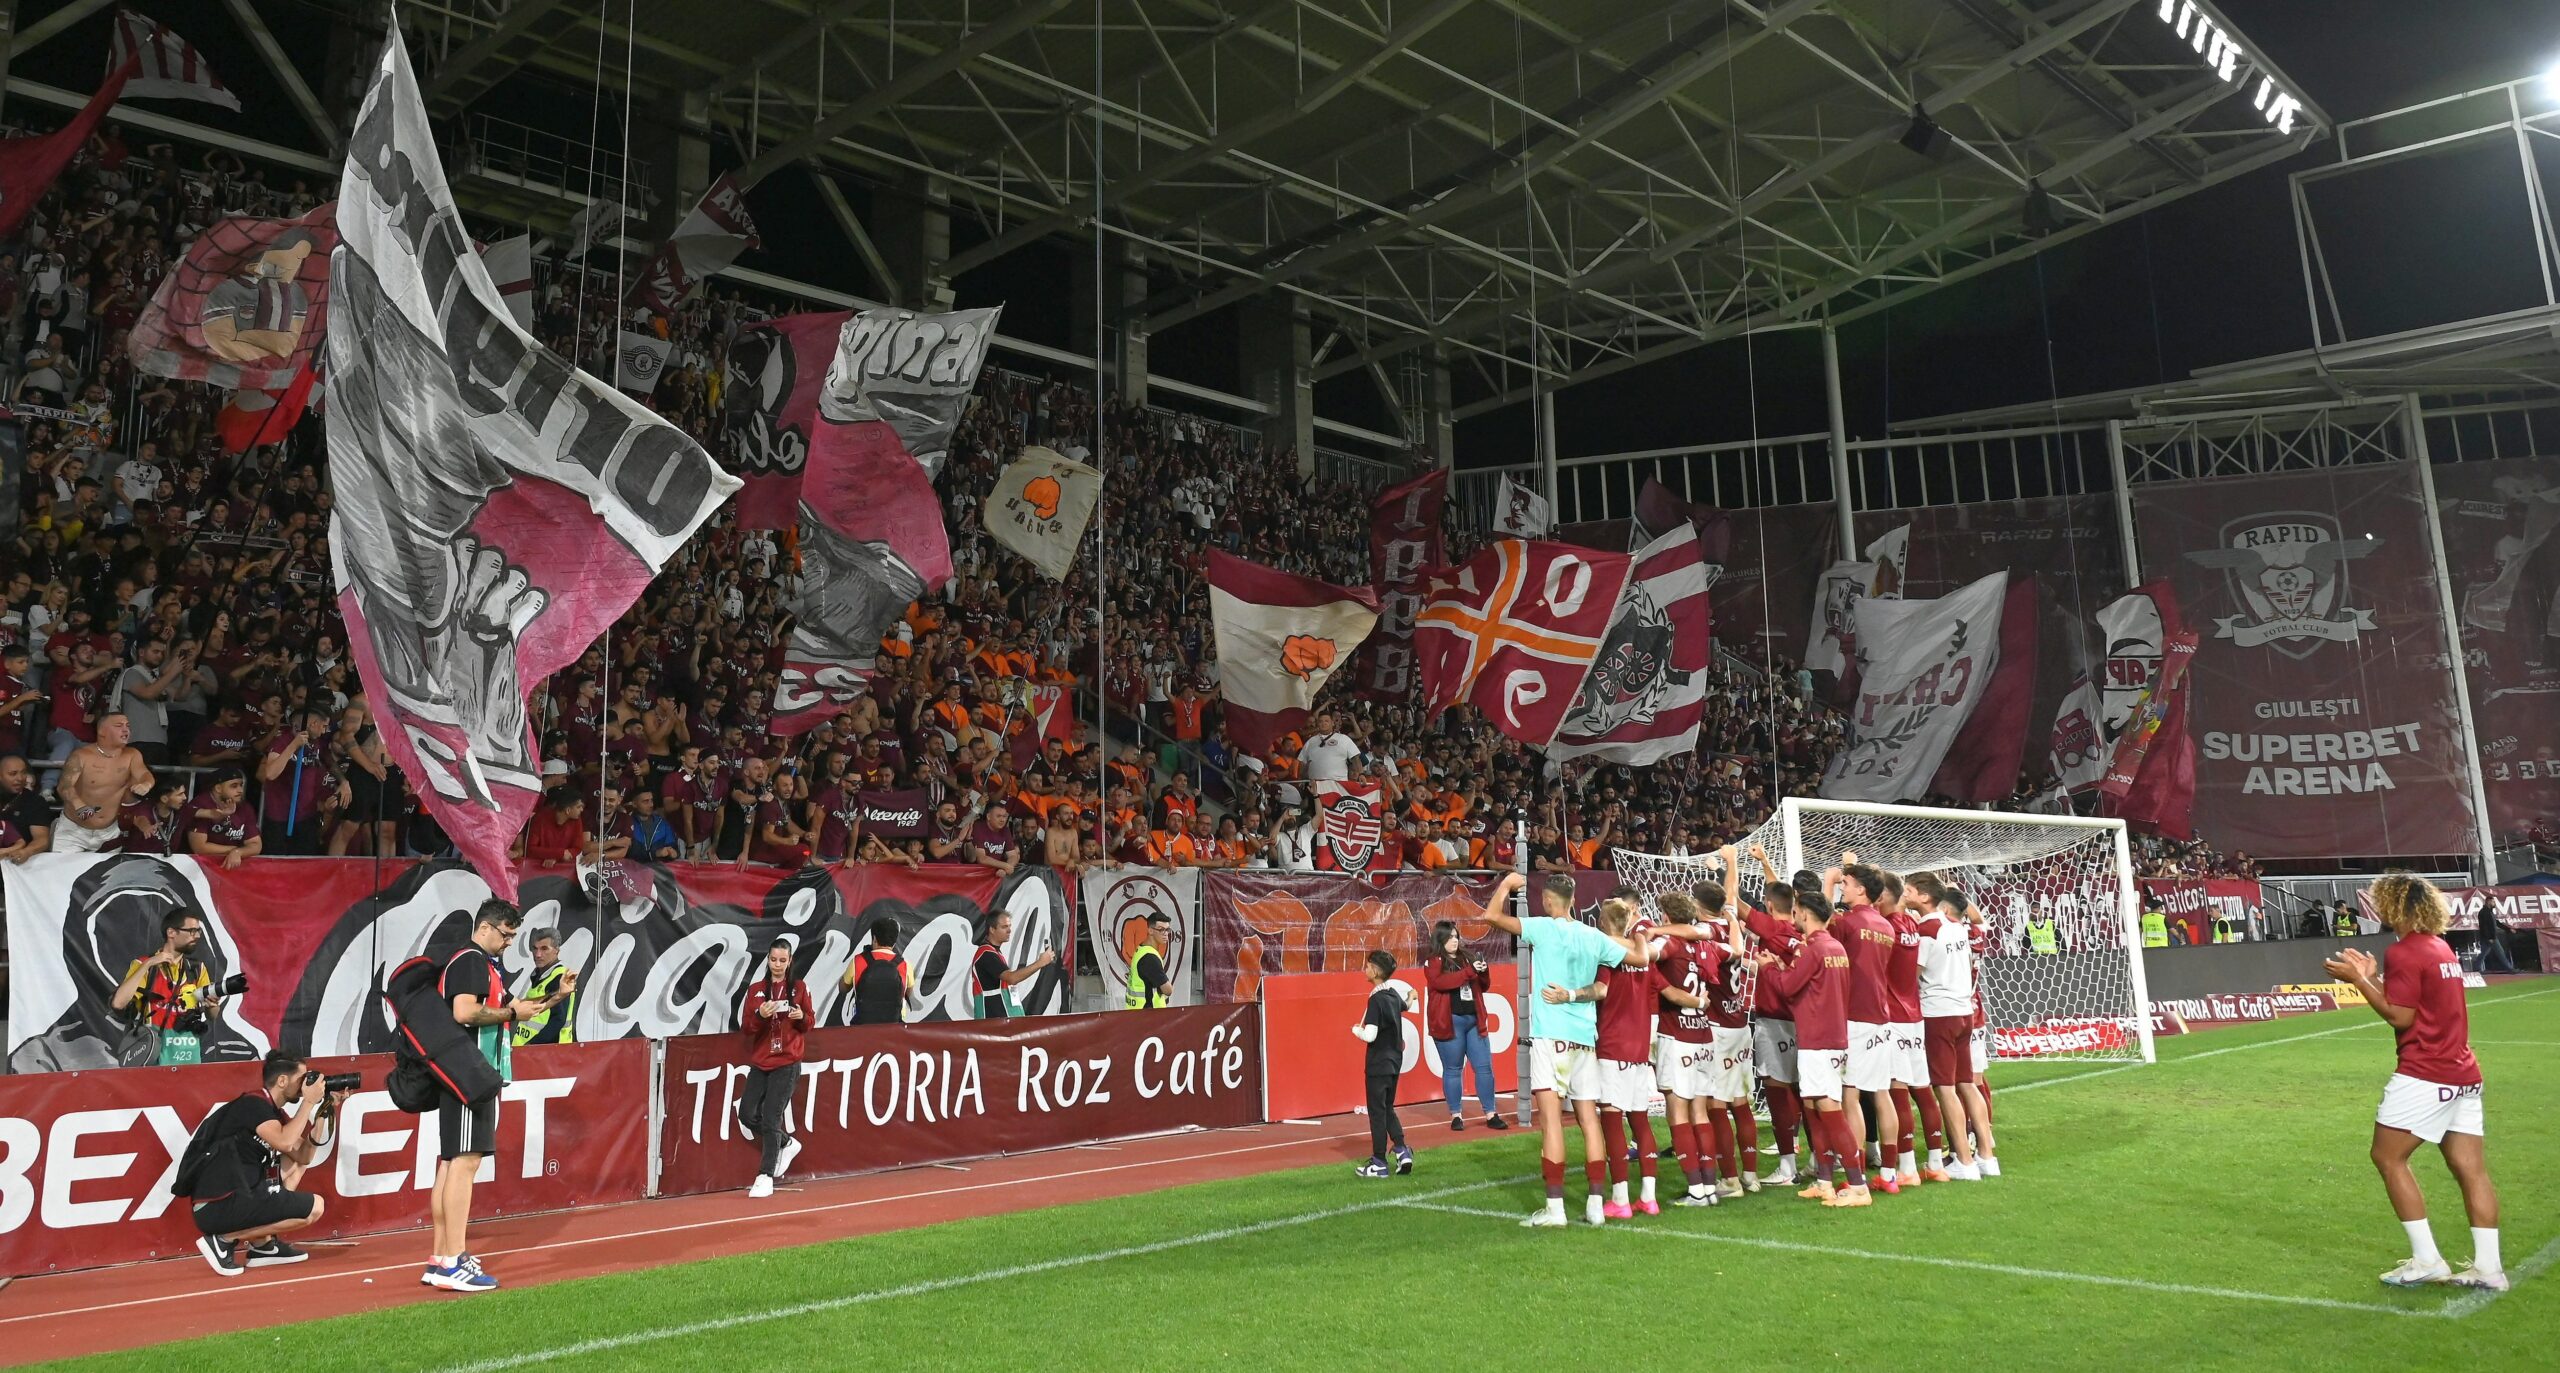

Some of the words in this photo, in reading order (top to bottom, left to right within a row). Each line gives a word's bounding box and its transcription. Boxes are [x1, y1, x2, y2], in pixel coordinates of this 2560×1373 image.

[2244, 526, 2319, 548] RAPID
[2263, 624, 2300, 638] FOTBAL
[2302, 624, 2329, 635] CLUB
[2255, 698, 2360, 721] GIULEȘTI
[2202, 722, 2421, 763] SUPERBET
[2241, 762, 2396, 796] ARENA
[2212, 996, 2239, 1019] Roz
[2240, 996, 2272, 1020] Café
[166, 1036, 197, 1047] FOTO
[1992, 1028, 2102, 1053] SUPERBET
[172, 1050, 193, 1062] 423
[686, 1046, 986, 1145] TRTTORIA
[1017, 1045, 1111, 1113] Roz
[1134, 1024, 1244, 1099] Café
